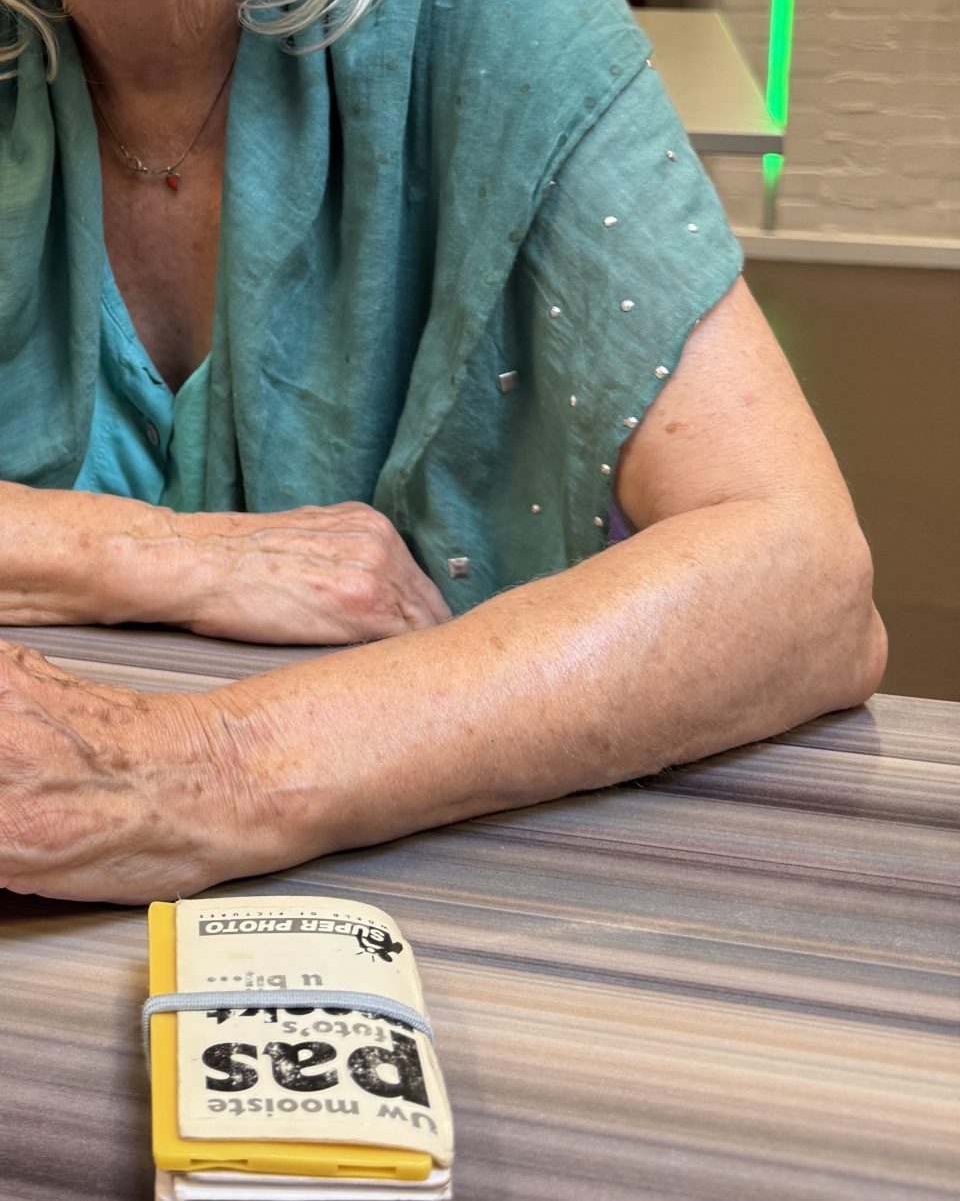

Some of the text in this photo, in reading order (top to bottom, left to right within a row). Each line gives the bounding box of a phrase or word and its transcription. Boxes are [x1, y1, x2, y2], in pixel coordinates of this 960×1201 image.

[204, 918, 386, 941] SUPER PHOTO
[333, 912, 390, 929] WORLD
[301, 973, 323, 986] u
[282, 1019, 388, 1042] foto's
[202, 1030, 431, 1108] pas
[208, 1098, 439, 1135] Uw mooiste
